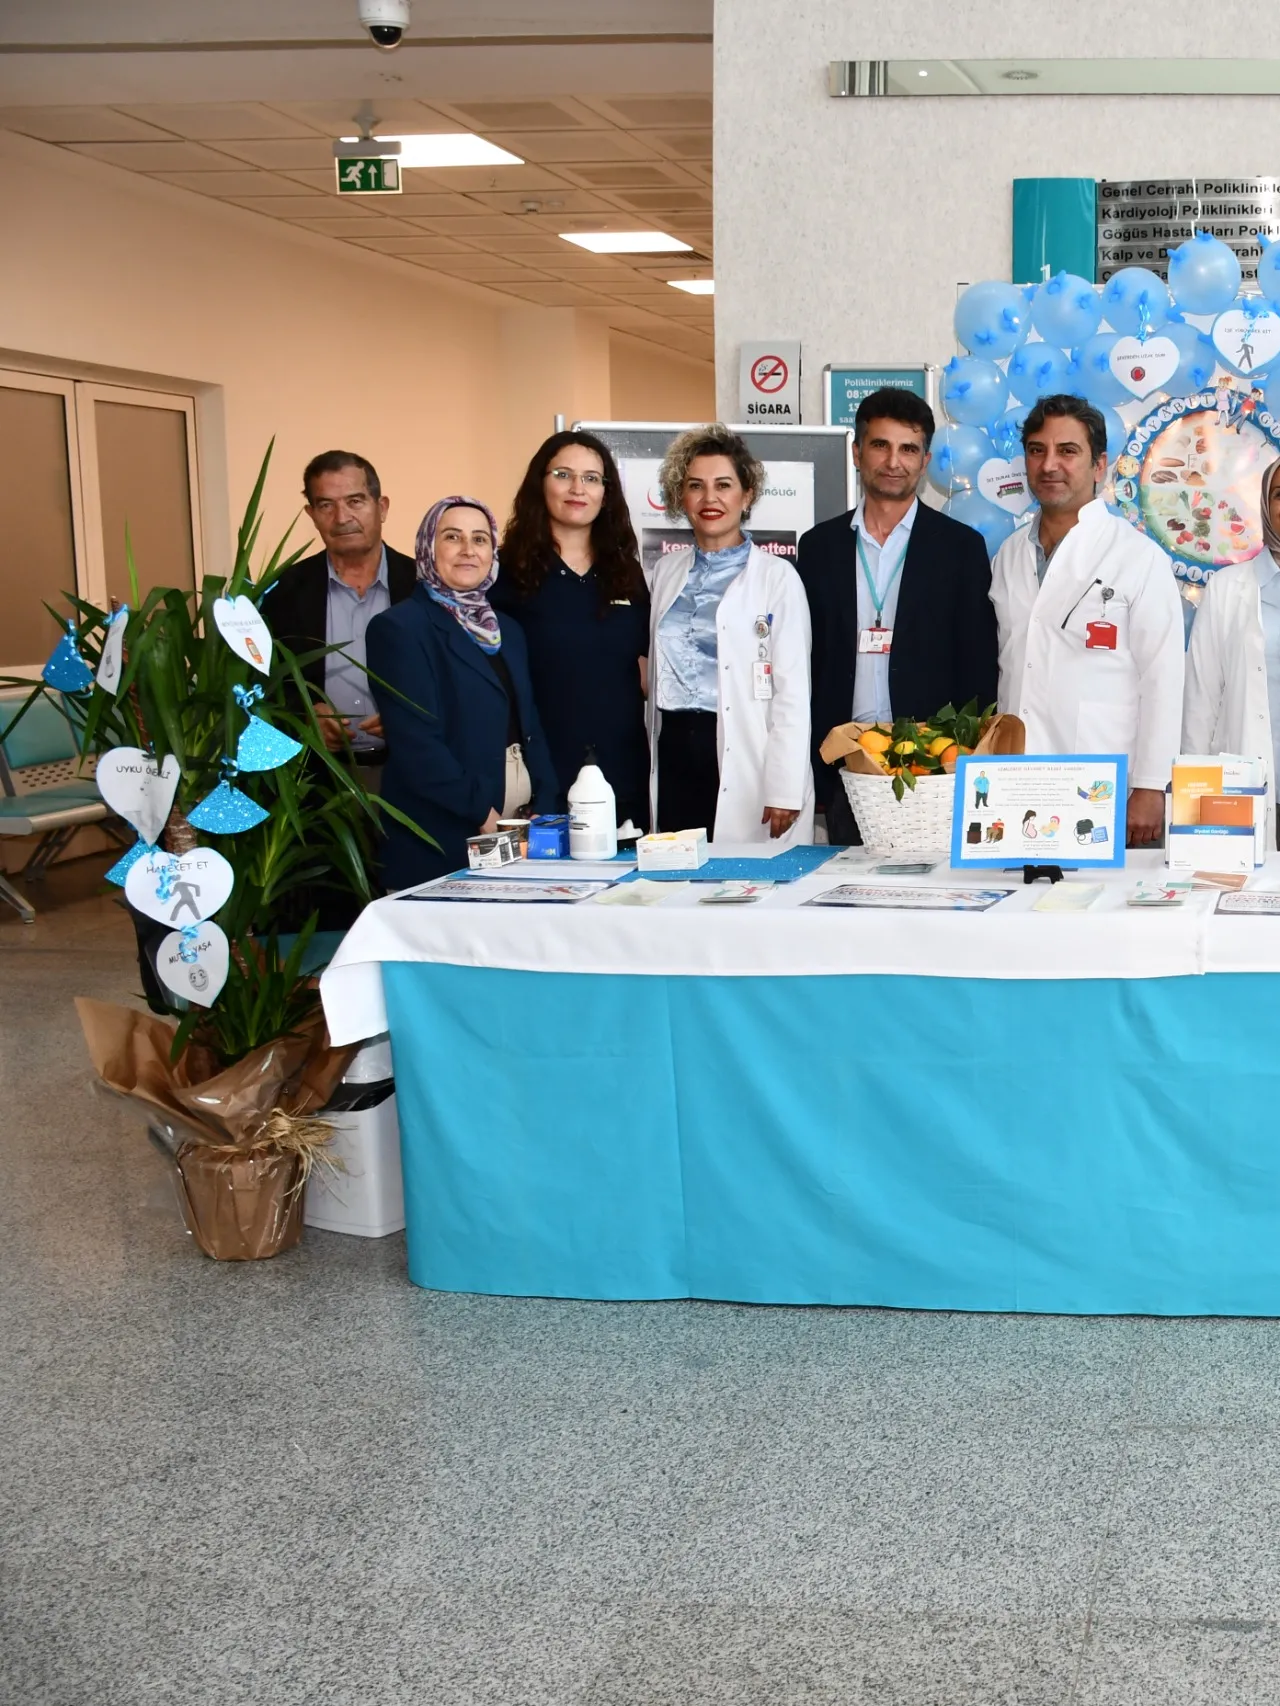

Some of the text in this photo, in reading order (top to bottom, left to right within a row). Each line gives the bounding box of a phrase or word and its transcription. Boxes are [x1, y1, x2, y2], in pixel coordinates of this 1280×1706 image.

[1102, 186, 1142, 198] Genel
[1146, 183, 1199, 196] Cerrahi
[1102, 204, 1273, 220] Kardiyoloji Poliklinikleri
[1103, 228, 1148, 242] Göğüs
[1153, 225, 1233, 237] Hastalkları
[1102, 250, 1133, 262] Kalp
[1137, 250, 1154, 259] ve
[844, 378, 914, 387] Polikliniklerimiz
[747, 400, 791, 414] SİGARA
[115, 765, 142, 774] UYKU
[196, 861, 209, 870] ET
[168, 951, 192, 964] MUTL
